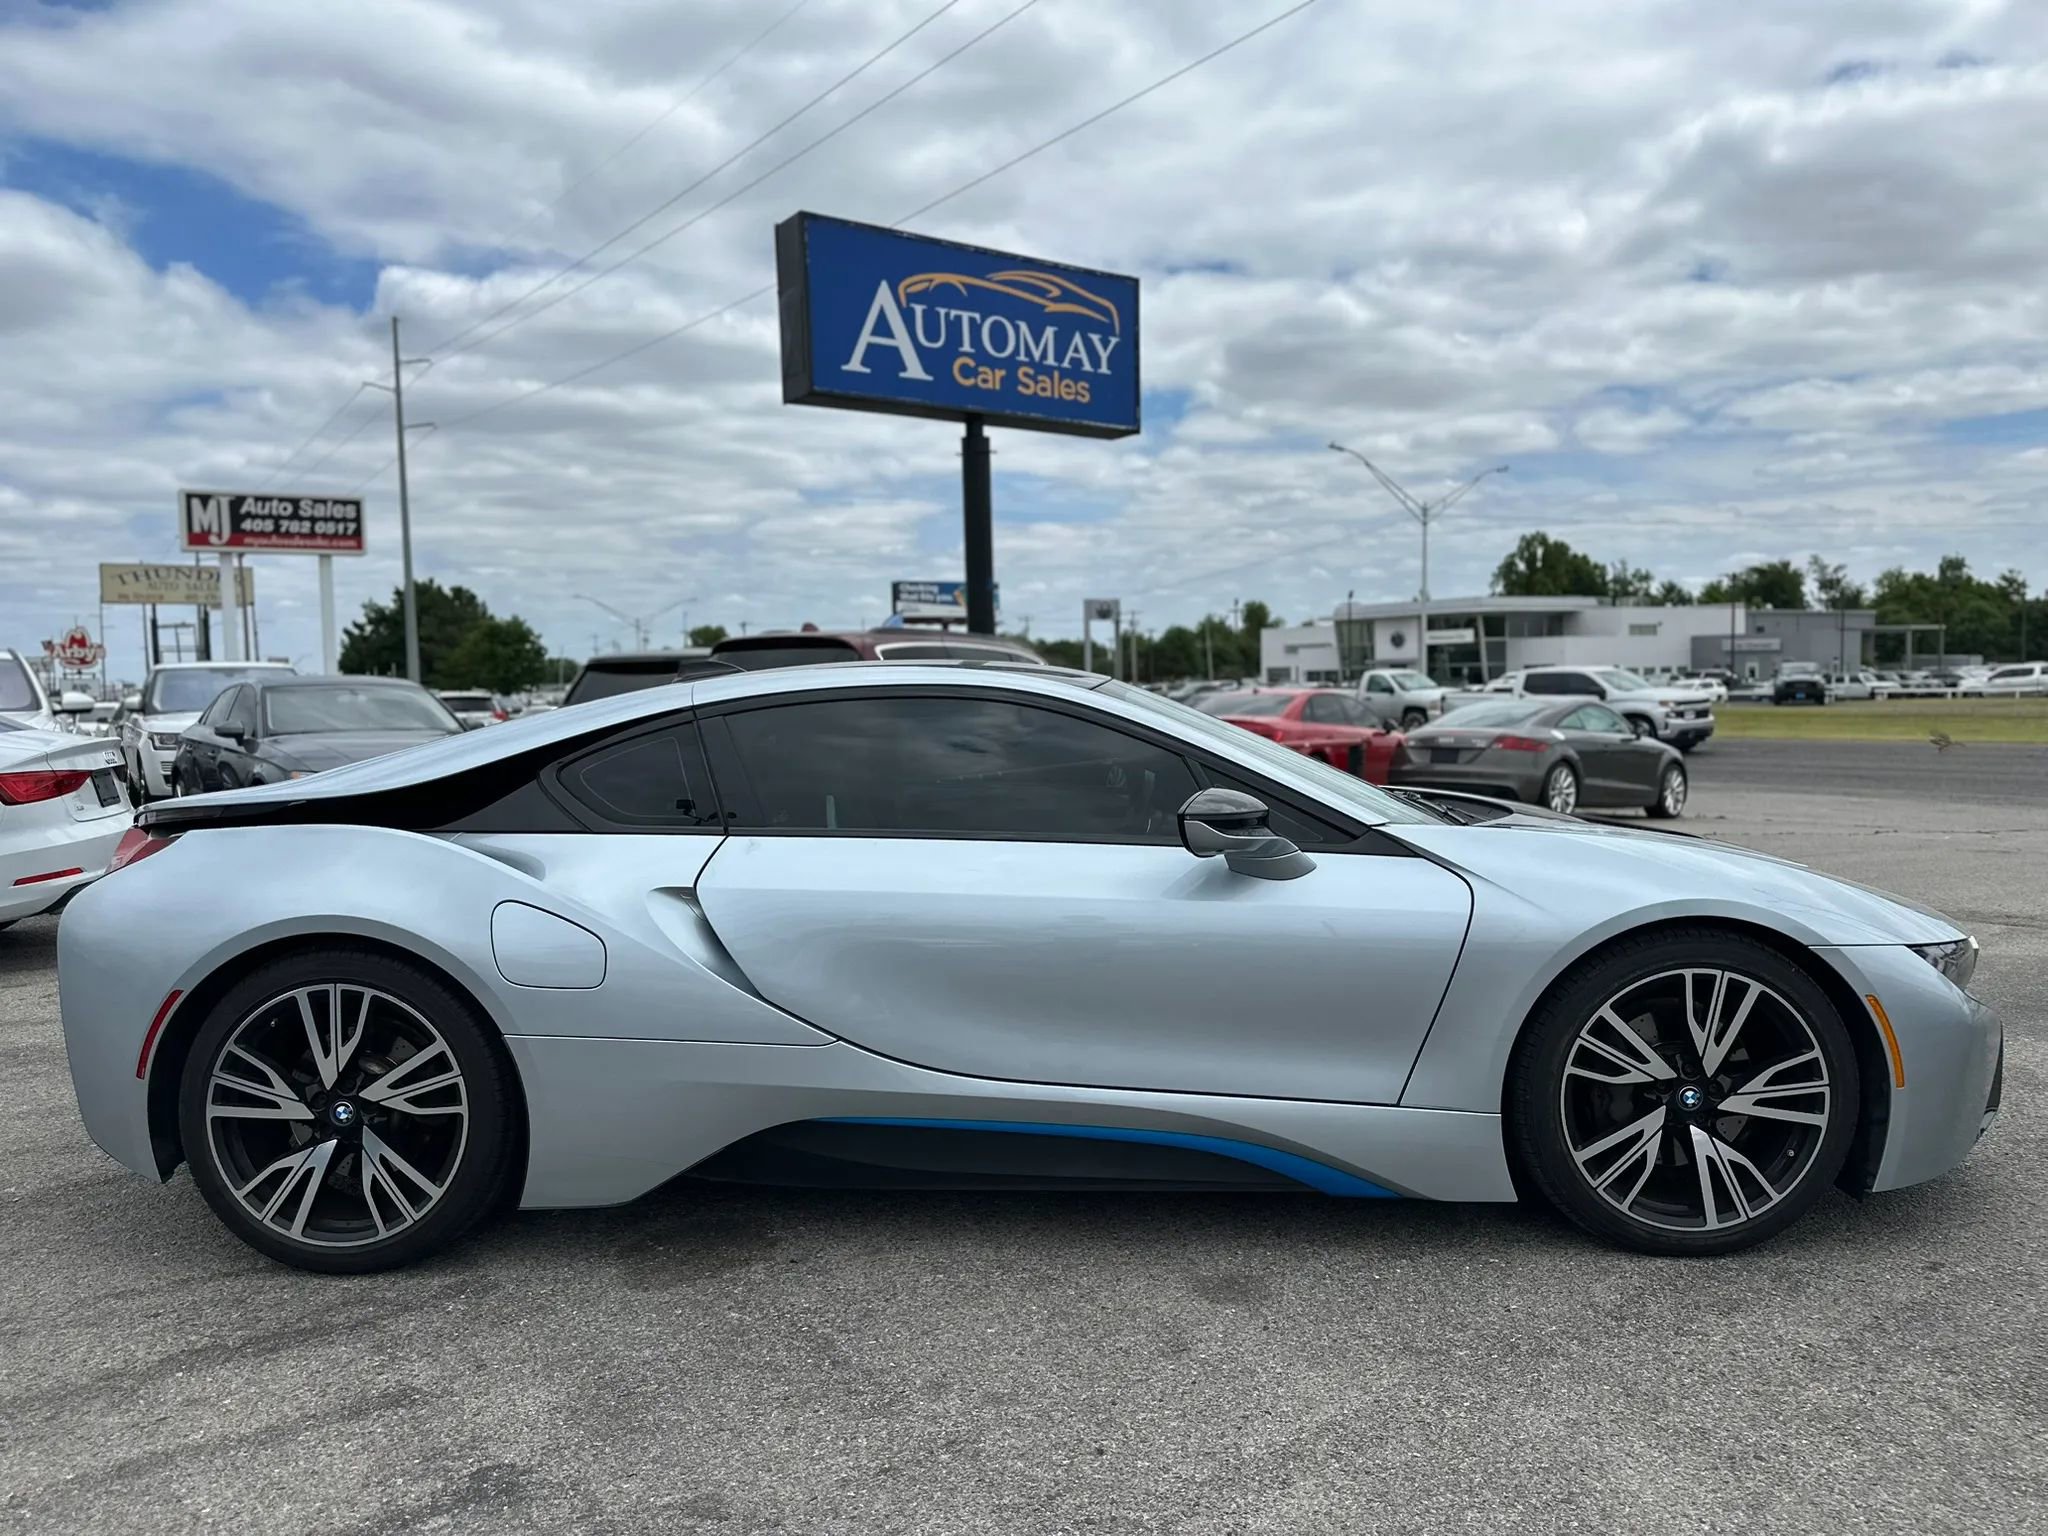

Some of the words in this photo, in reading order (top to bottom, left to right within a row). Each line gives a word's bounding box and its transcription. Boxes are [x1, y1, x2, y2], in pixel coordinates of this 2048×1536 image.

[841, 279, 1120, 381] AUTOMAY
[952, 356, 1006, 390] Car
[1017, 366, 1090, 403] Sales
[190, 496, 234, 545] MJ
[240, 497, 293, 516] Auto
[298, 499, 357, 519] Sales
[240, 518, 274, 532] 405
